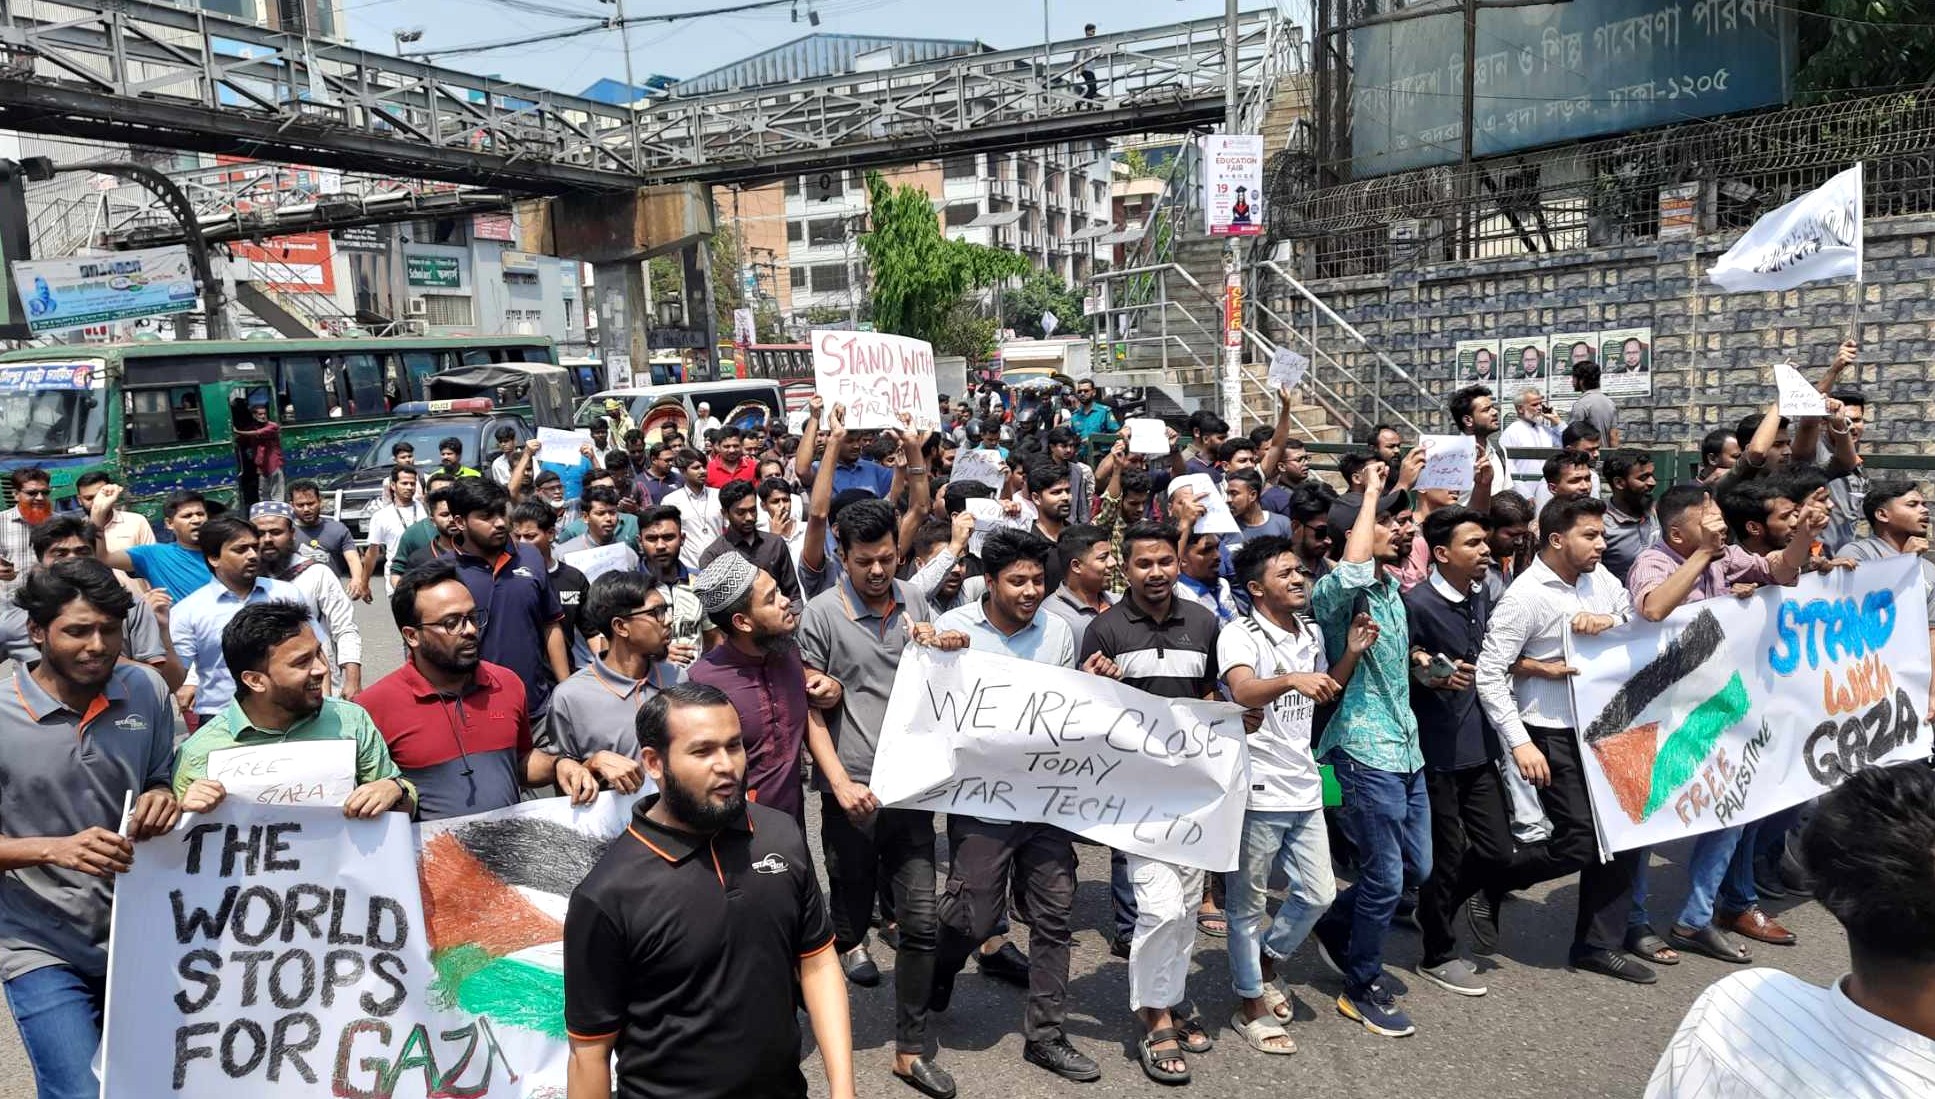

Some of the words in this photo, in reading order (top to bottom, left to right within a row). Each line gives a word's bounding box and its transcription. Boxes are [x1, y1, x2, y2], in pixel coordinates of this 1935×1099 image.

[1518, 46, 1534, 76] ও
[1594, 2, 1681, 57] গবেষণা
[1608, 68, 1730, 108] ঢাকা-১২০৫
[1215, 157, 1257, 165] EDUCATION
[1217, 184, 1228, 194] 19
[821, 334, 894, 377] STAND
[899, 344, 934, 377] WITH
[430, 402, 449, 410] POLICE
[873, 376, 922, 411] GAZA
[1769, 588, 1896, 676] STAND
[927, 678, 1011, 732] WE
[1016, 691, 1091, 746] ARE
[1105, 708, 1225, 758] CLOSE
[1803, 687, 1919, 788] GAZA
[217, 750, 293, 778] FREE
[257, 782, 324, 803] GAZA
[1025, 752, 1122, 785] TODAY
[1675, 749, 1738, 828] FREE
[1714, 716, 1772, 826] PALESTINE
[917, 777, 1016, 810] STAR
[1038, 786, 1126, 825] TECH
[1135, 806, 1202, 845] LTD
[182, 822, 302, 876] THE
[169, 883, 409, 951] WORLD
[174, 948, 407, 1017] STOPS
[172, 1012, 321, 1090] FOR
